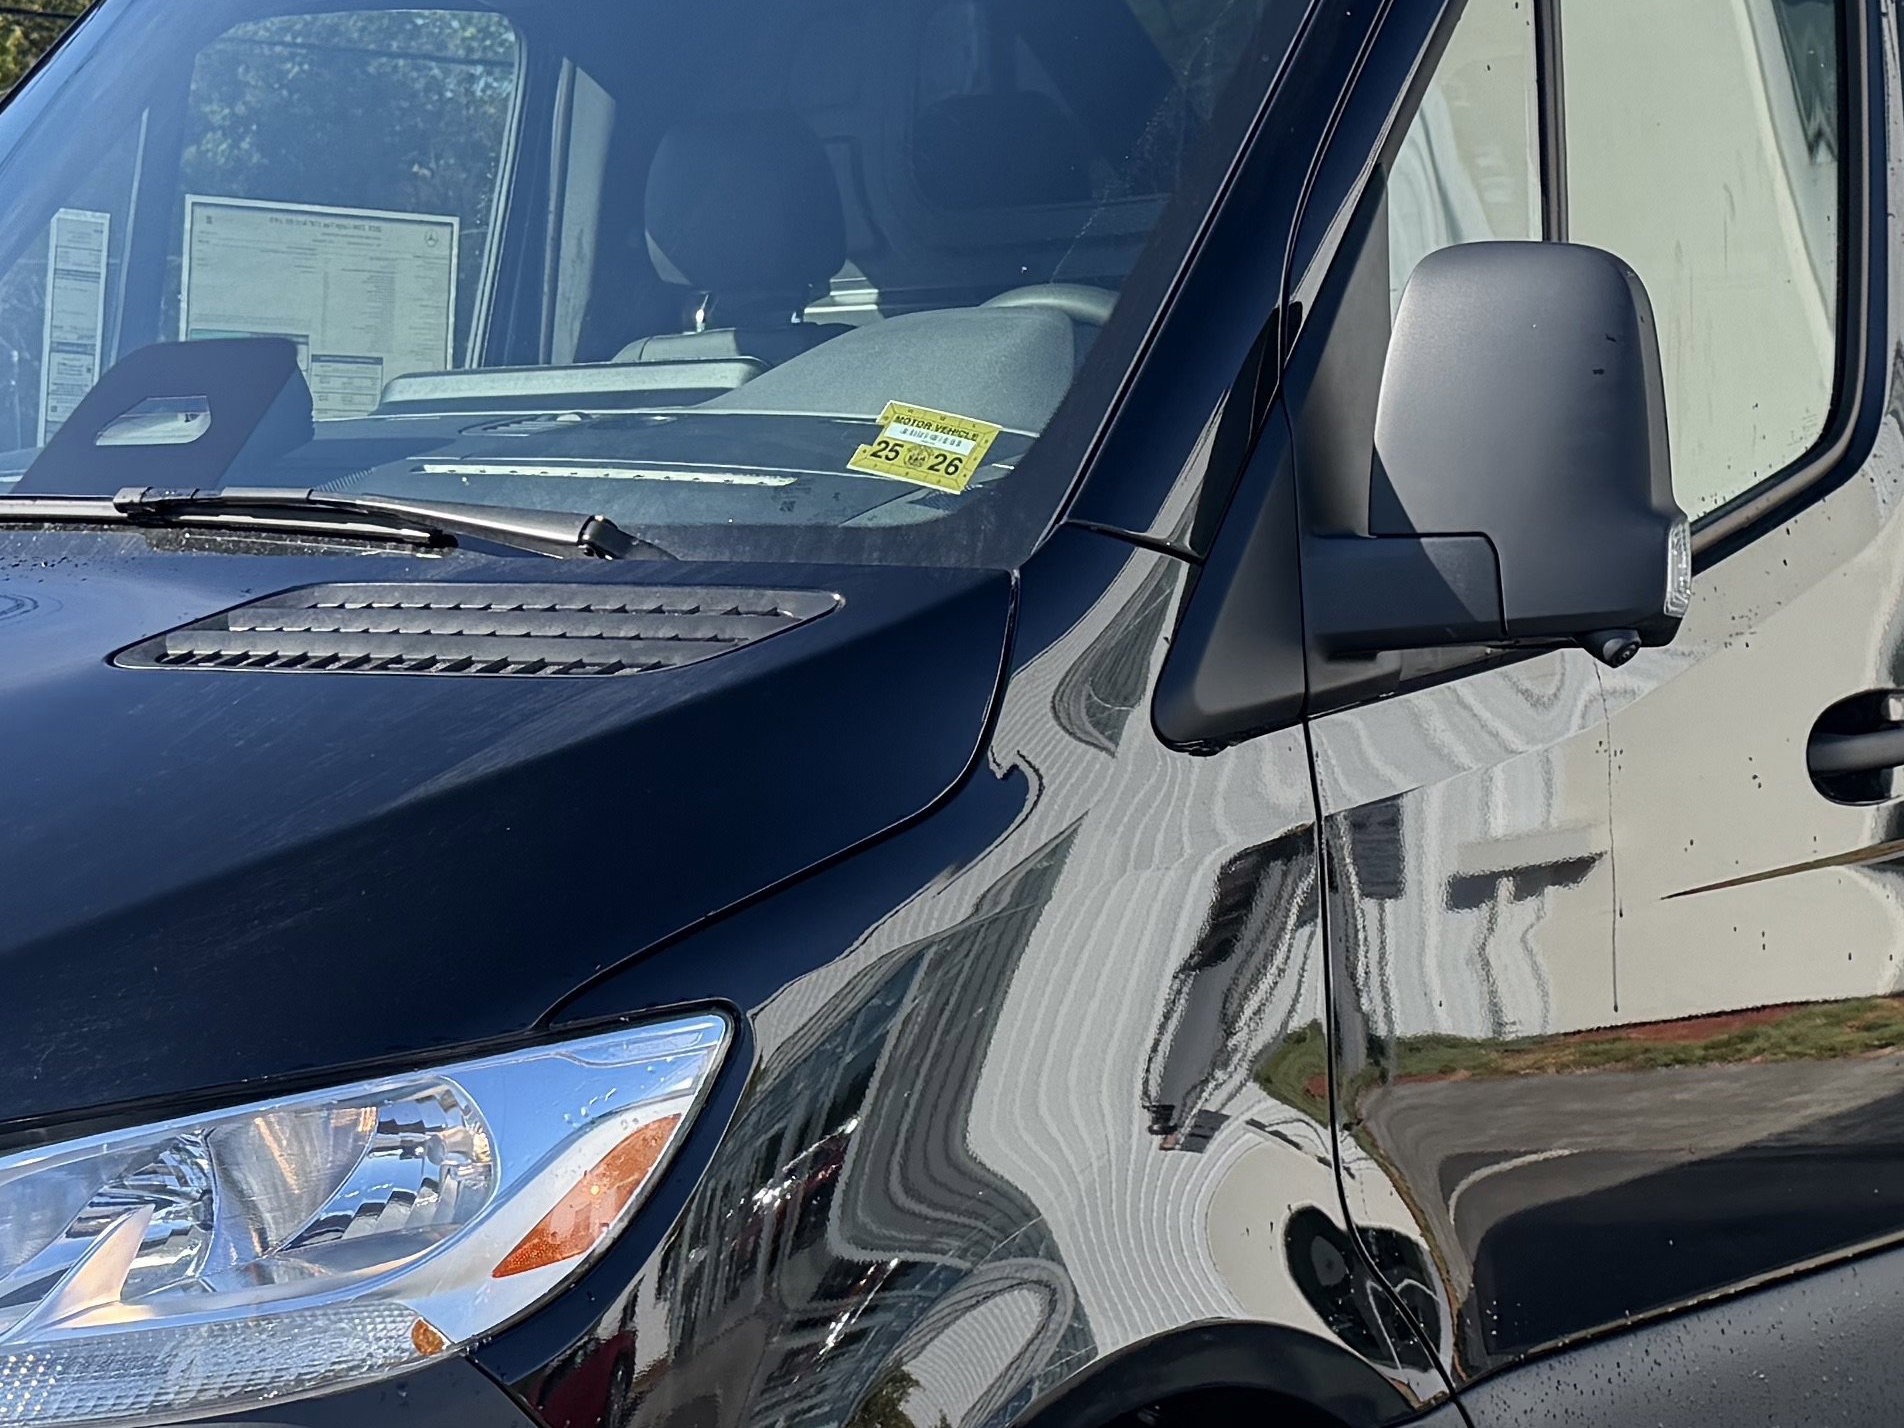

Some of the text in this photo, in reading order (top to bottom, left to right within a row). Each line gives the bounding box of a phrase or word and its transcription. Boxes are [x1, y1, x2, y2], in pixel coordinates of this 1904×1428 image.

[893, 415, 933, 431] MOTOR
[935, 424, 980, 442] VEHICLE
[869, 440, 964, 476] 25 26
